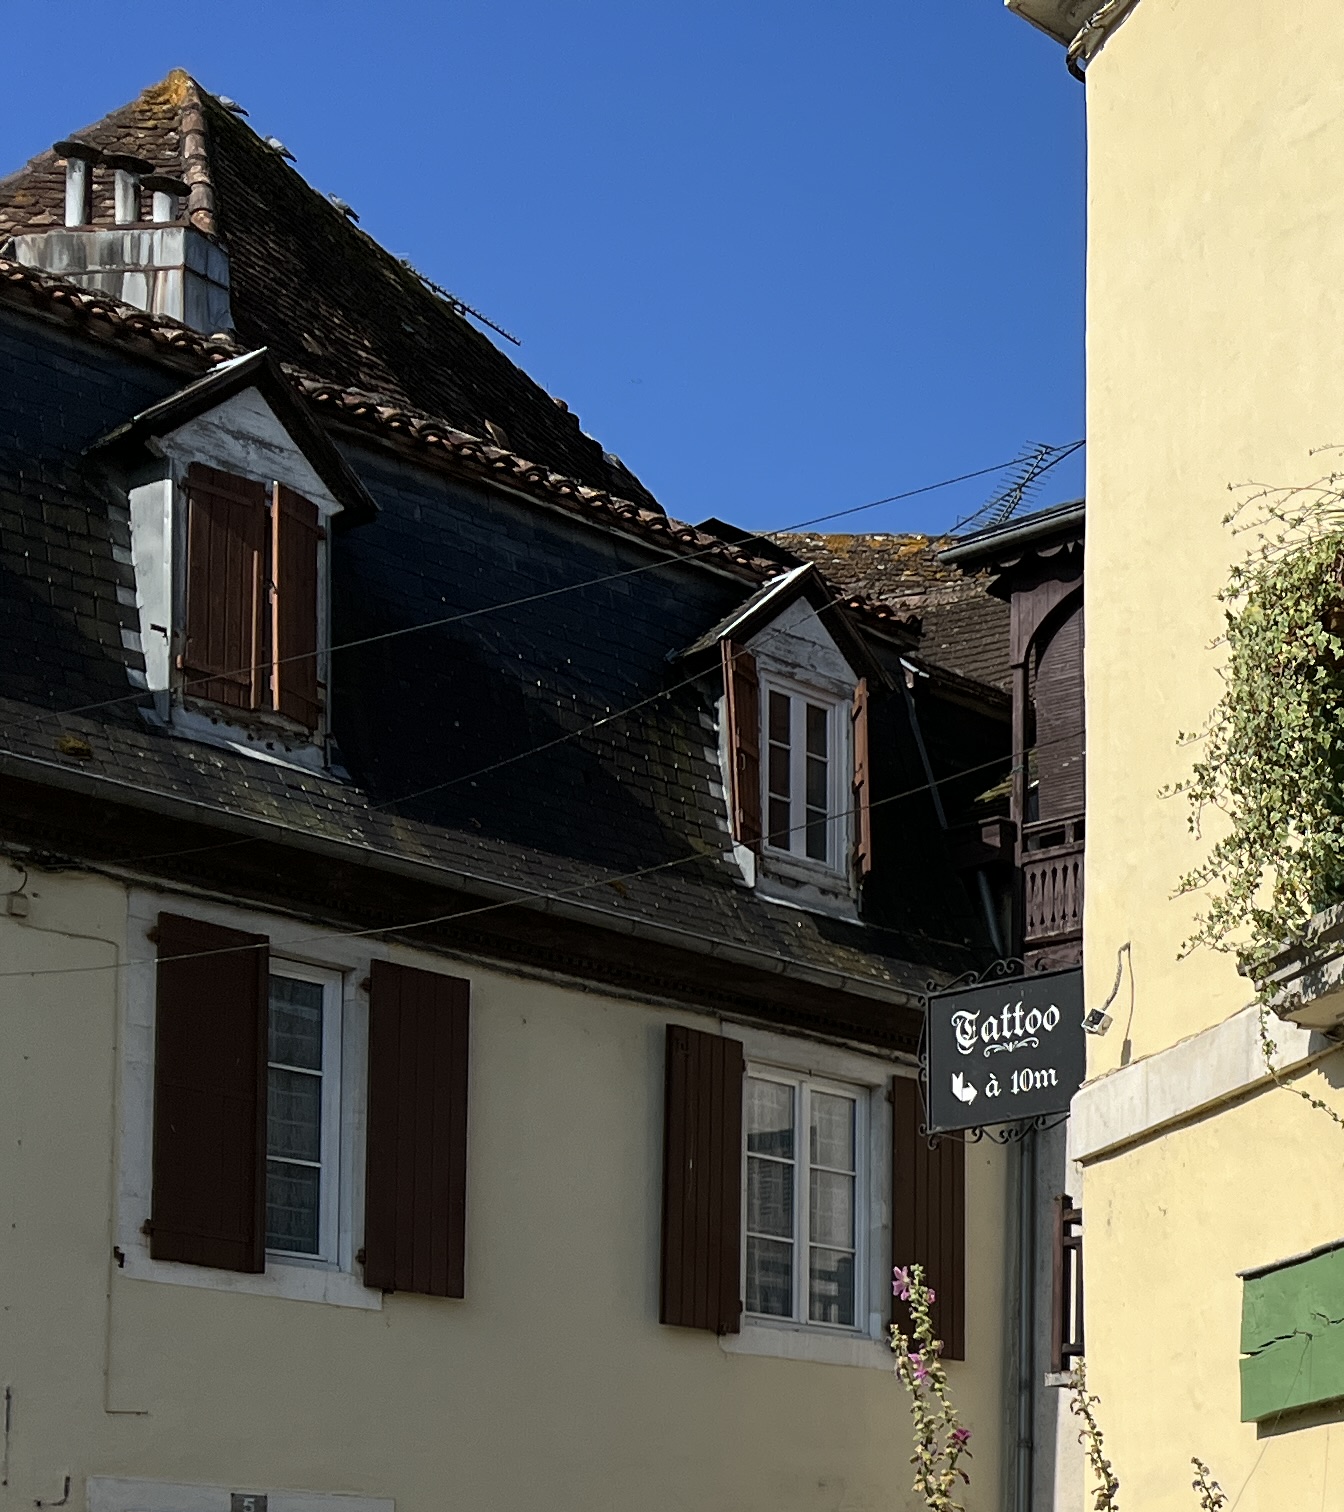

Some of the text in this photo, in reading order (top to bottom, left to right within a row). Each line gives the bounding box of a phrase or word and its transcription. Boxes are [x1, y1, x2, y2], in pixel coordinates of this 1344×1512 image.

[951, 1001, 1060, 1055] Tattoo
[985, 1068, 1058, 1098] à 10m
